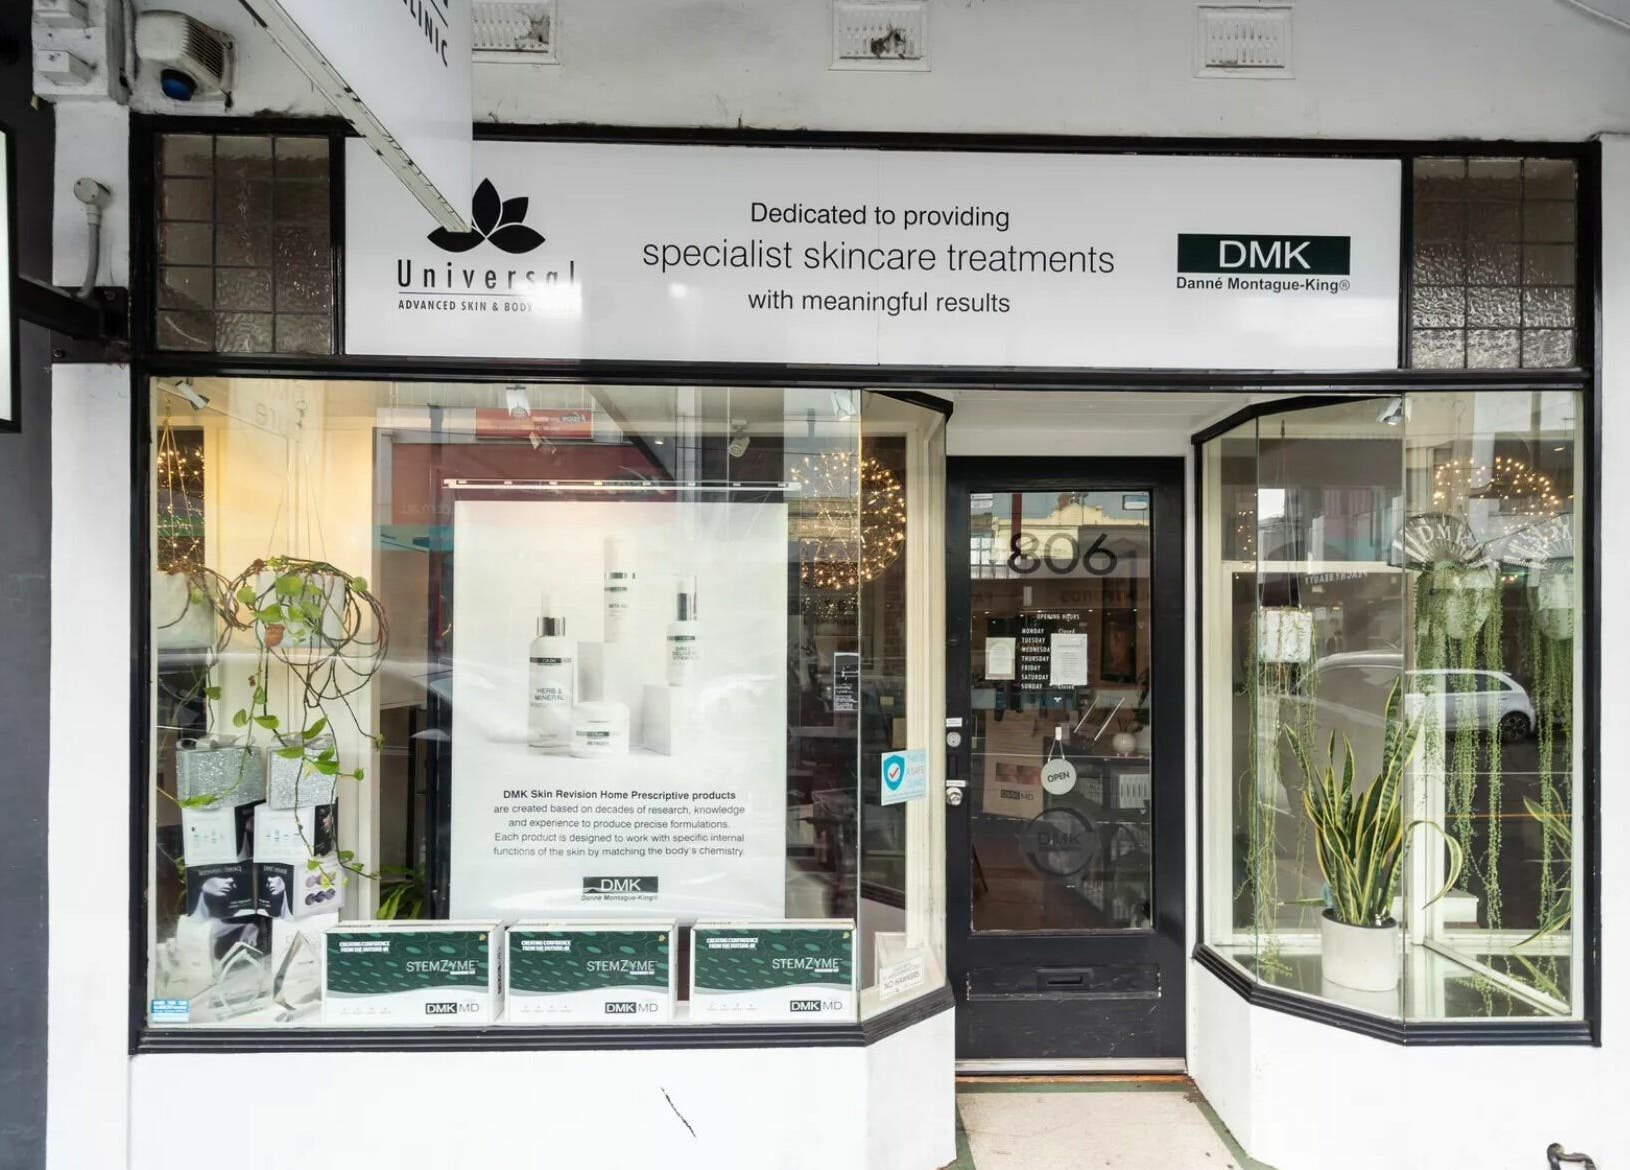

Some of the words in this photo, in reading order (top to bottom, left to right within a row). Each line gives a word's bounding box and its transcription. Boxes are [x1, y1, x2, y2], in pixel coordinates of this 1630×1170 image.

[403, 0, 448, 67] LINIC
[751, 202, 867, 225] Dedicated
[874, 205, 896, 225] to
[903, 205, 1010, 231] providing
[642, 239, 793, 273] specialist
[804, 240, 936, 270] skincare
[947, 243, 1115, 274] treatments
[1219, 240, 1311, 269] DMK
[397, 259, 575, 289] Universal
[1176, 276, 1223, 290] Danné
[398, 299, 456, 311] ADVANCED
[461, 300, 487, 311] SKIN
[492, 301, 498, 311] &
[748, 290, 794, 310] with
[801, 291, 929, 316] meaningful
[936, 292, 1011, 313] results
[1007, 532, 1118, 576] 806
[1047, 771, 1070, 783] OPEN
[503, 790, 528, 799] DMK
[531, 790, 553, 799] Skin
[556, 790, 598, 799] Revision
[600, 790, 629, 799] Home
[631, 791, 690, 801] Prescriptive
[692, 791, 736, 802] products
[493, 806, 509, 814] are
[512, 804, 548, 813] created
[550, 804, 579, 813] based
[595, 804, 635, 814] decades
[637, 805, 646, 814] of
[694, 806, 746, 816] knowledge
[508, 819, 527, 827] and
[529, 819, 579, 829] experience
[581, 819, 591, 828] to
[593, 819, 632, 830] produce
[634, 820, 668, 830] precise
[494, 832, 519, 841] Each
[521, 832, 557, 843] product
[559, 833, 567, 841] is
[569, 834, 612, 844] designed
[614, 834, 624, 842] to
[626, 834, 649, 842] work
[650, 834, 670, 842] with
[672, 833, 709, 844] specific
[710, 834, 745, 842] internal
[493, 847, 535, 856] functions
[537, 847, 547, 856] of
[549, 847, 564, 856] the
[566, 847, 586, 856] skin
[588, 847, 599, 858] by
[602, 847, 646, 858] matching
[648, 847, 663, 856] the
[600, 878, 641, 891] DMK
[406, 960, 476, 972] STEMZYME
[586, 960, 655, 972] STEMZYME
[771, 957, 839, 970] STEMZYME
[427, 1004, 456, 1013] DMK
[459, 1003, 480, 1012] MD
[606, 1003, 635, 1013] DMK
[638, 1003, 659, 1012] MD
[791, 1001, 820, 1011] DMK
[822, 1001, 843, 1011] MD
